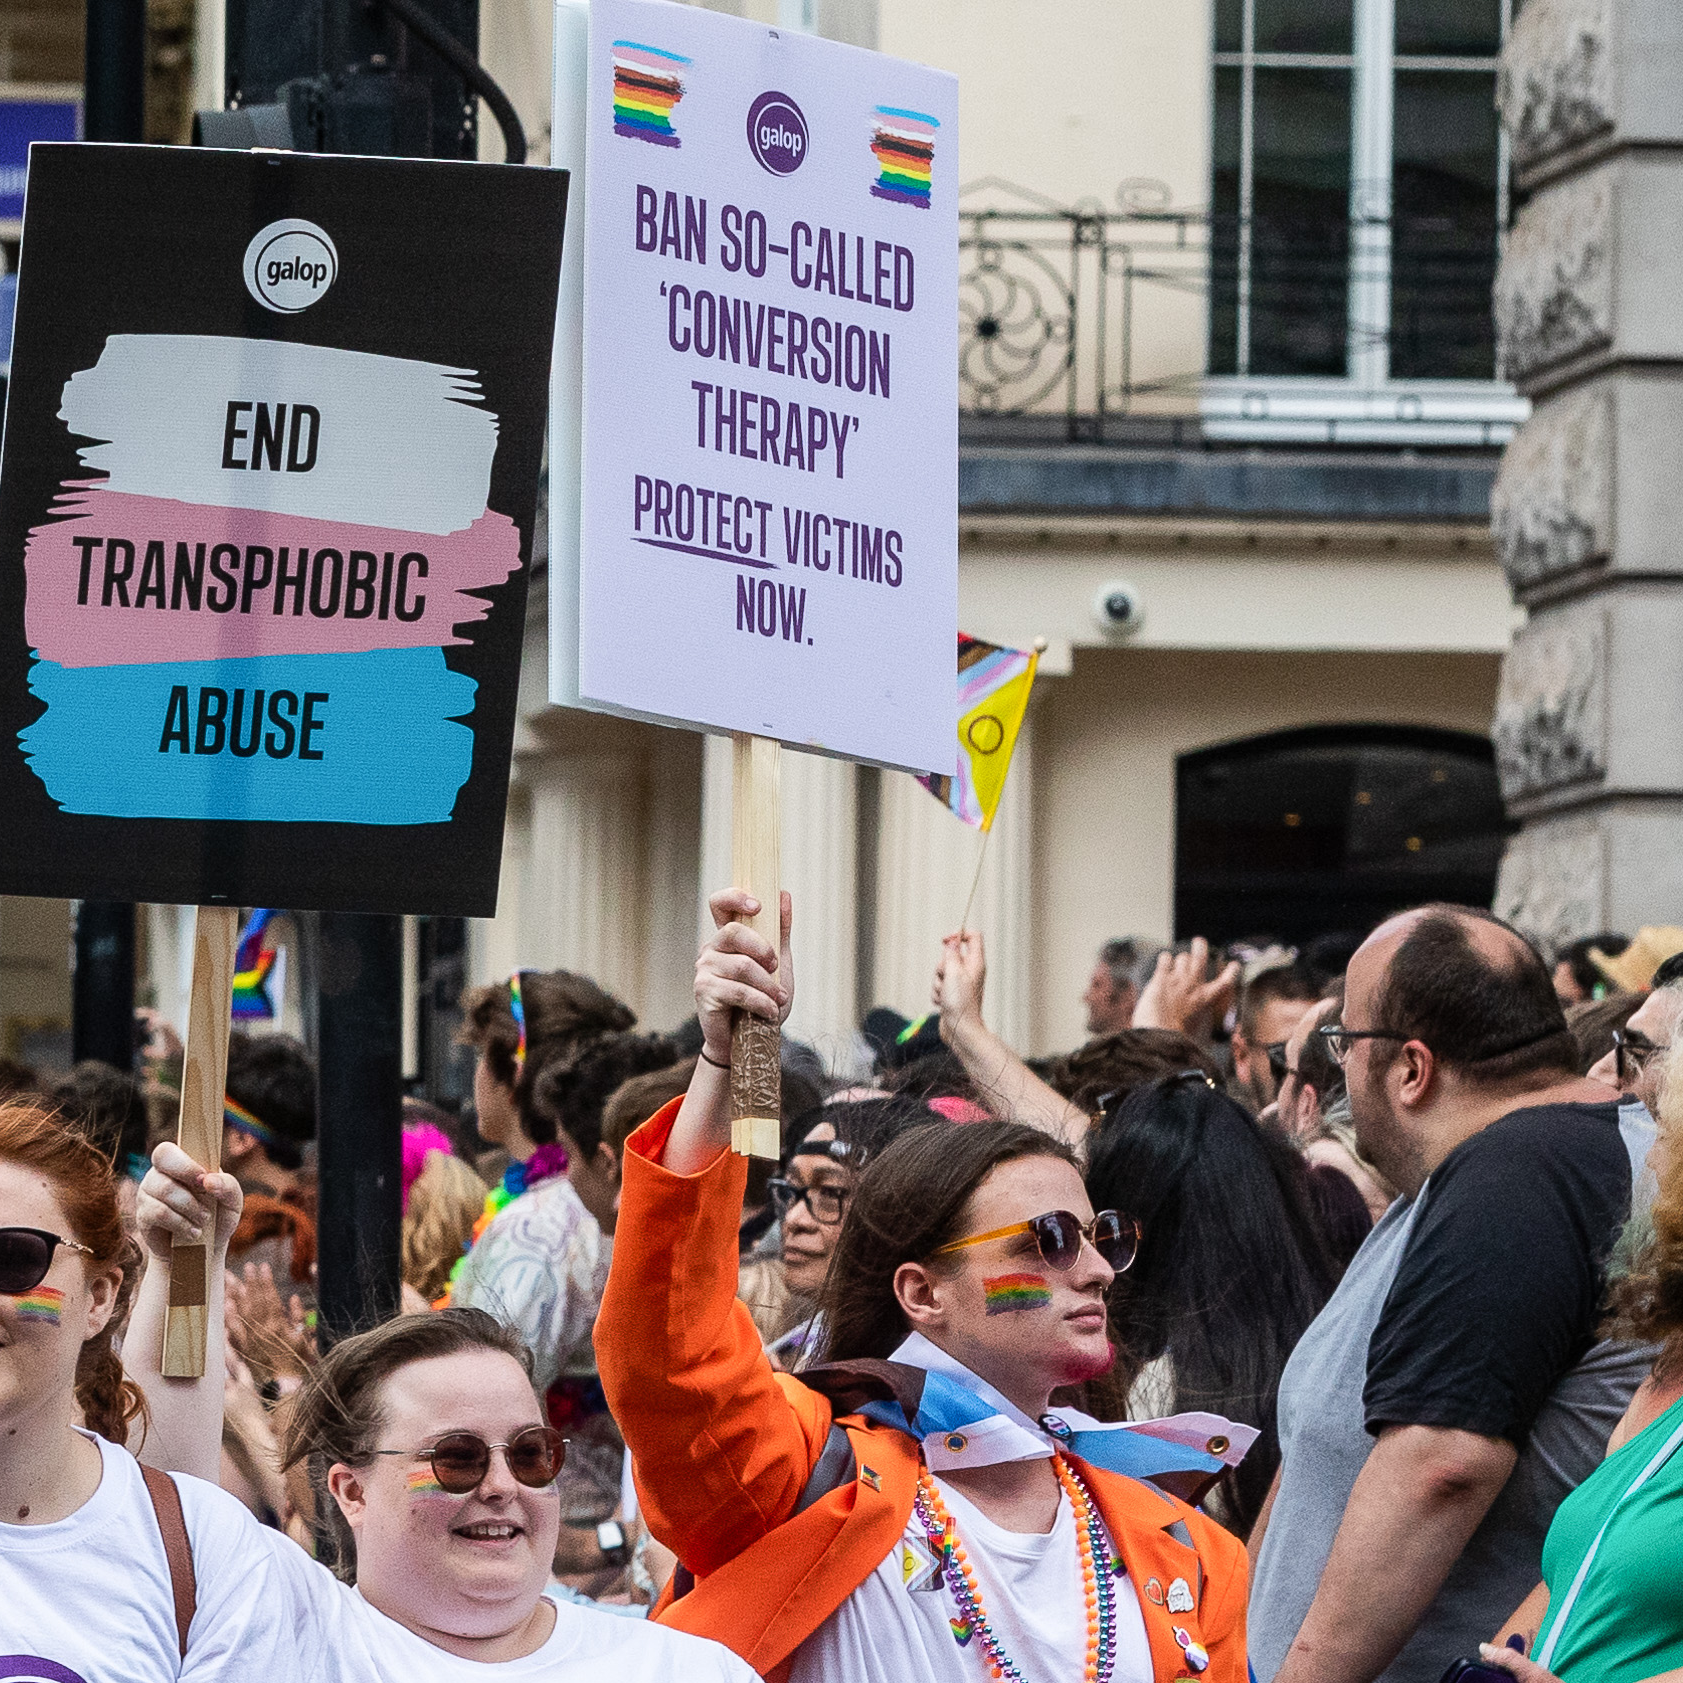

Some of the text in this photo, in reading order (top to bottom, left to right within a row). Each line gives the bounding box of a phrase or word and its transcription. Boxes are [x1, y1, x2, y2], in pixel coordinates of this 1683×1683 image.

[760, 124, 803, 157] galop
[266, 254, 328, 289] galop
[636, 184, 915, 312] BAN SO-CALLED
[221, 401, 321, 474] END
[634, 475, 904, 588] PROTECT VICTIMS
[73, 536, 430, 623] TRANSPHOBIC
[736, 574, 814, 647] NOW.
[158, 684, 331, 760] ABUSE
